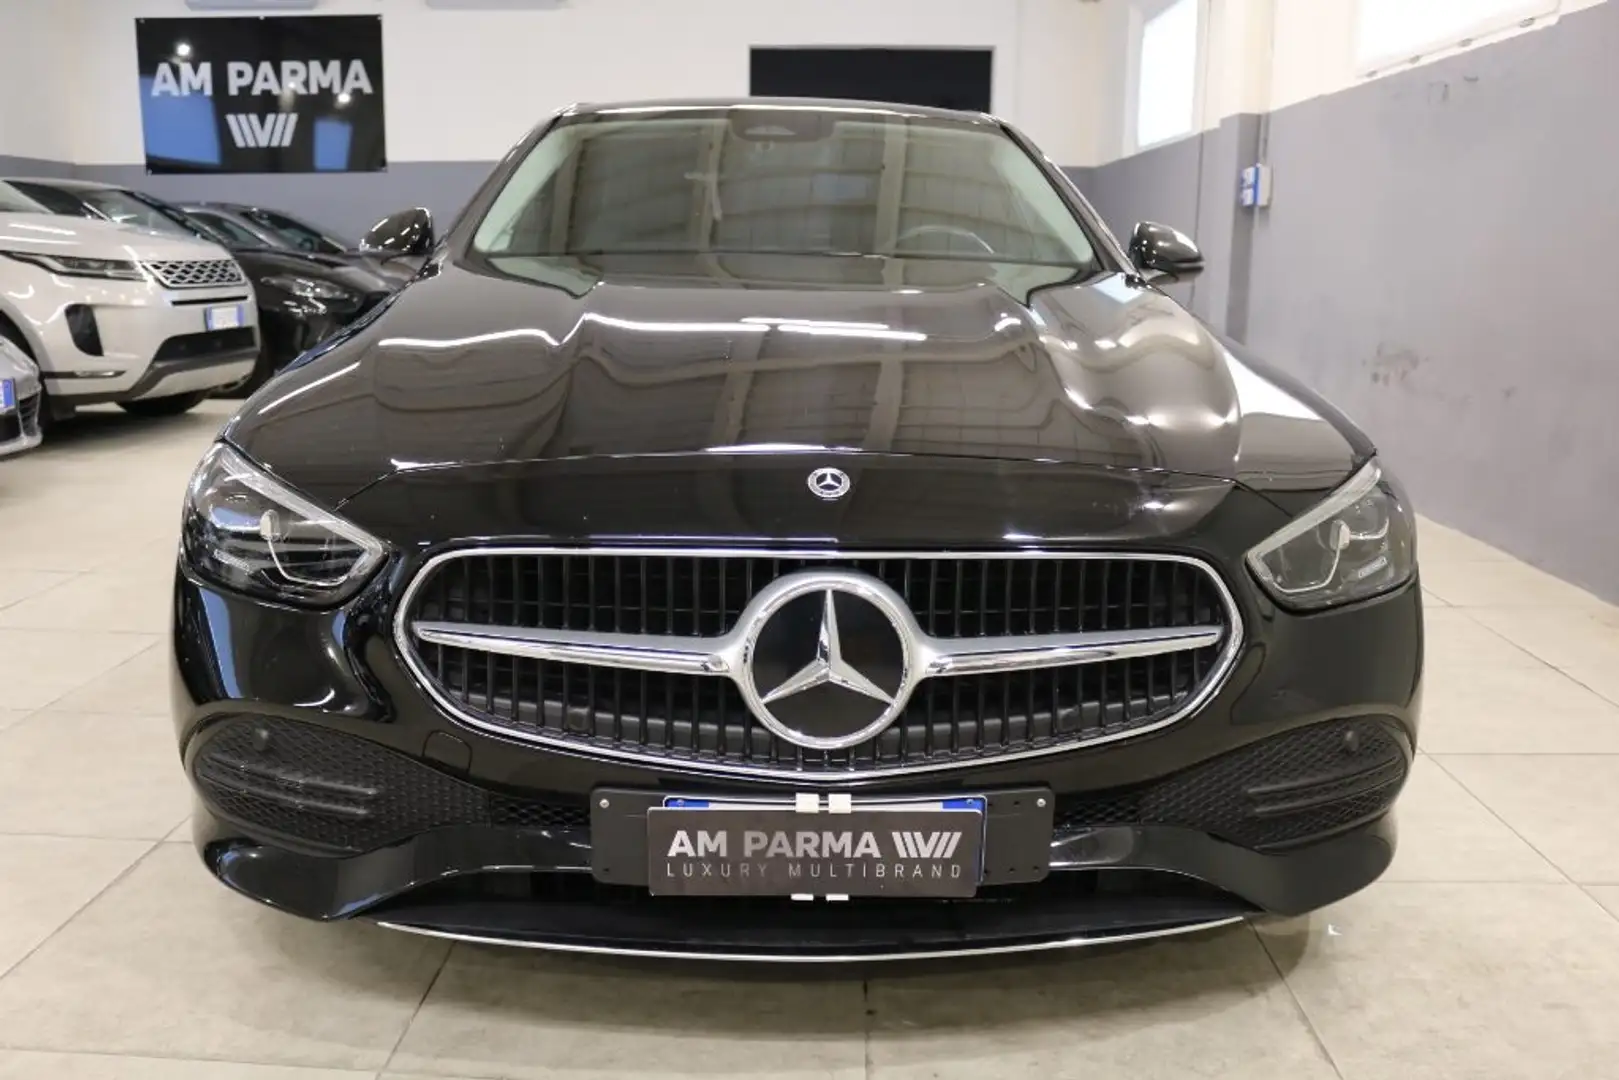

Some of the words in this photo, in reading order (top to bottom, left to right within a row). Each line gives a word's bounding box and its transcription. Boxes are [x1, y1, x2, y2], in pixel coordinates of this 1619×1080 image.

[151, 61, 213, 97] AM
[227, 58, 374, 97] PARMA
[667, 830, 727, 858] AM
[744, 830, 882, 859] PARMA
[666, 863, 768, 878] LUXURY
[788, 863, 962, 879] MULTIBRAND
